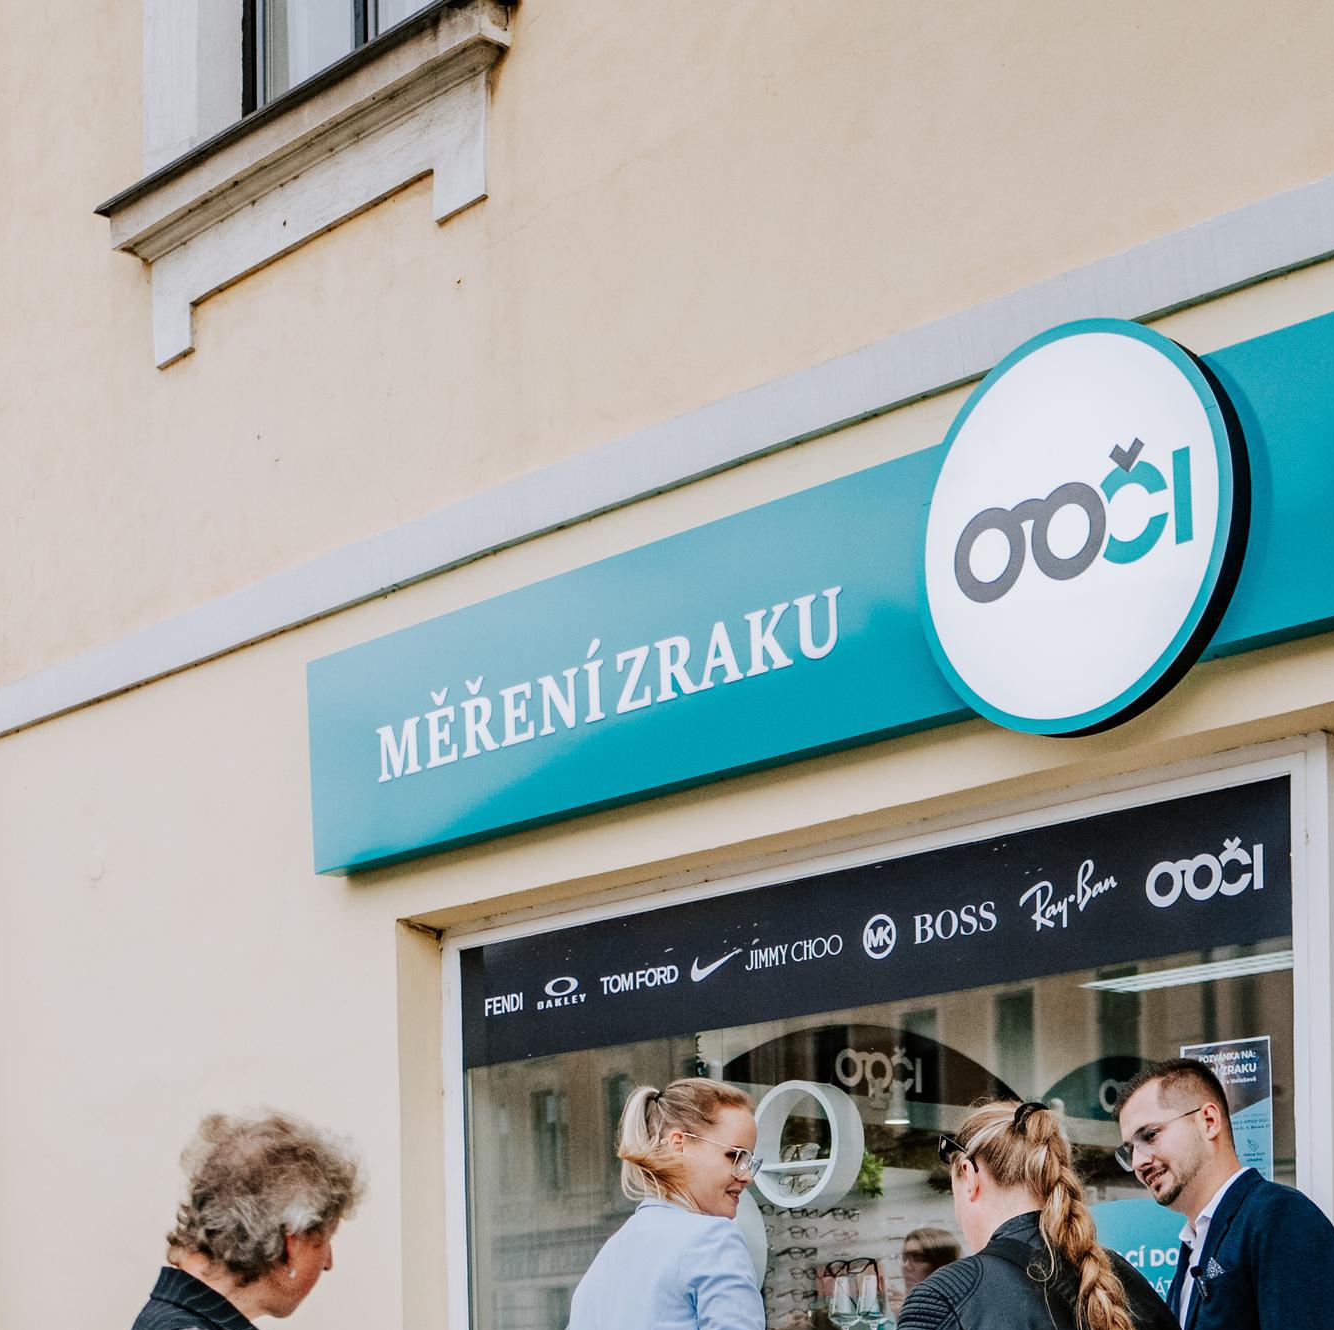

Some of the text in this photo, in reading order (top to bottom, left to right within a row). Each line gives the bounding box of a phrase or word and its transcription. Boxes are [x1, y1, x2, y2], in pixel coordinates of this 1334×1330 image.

[376, 586, 842, 783] MĚŘENÍ ZRAKU
[913, 901, 998, 944] BOSS
[745, 934, 843, 971] JIMMY CHOO
[600, 965, 679, 995] TOM FORD
[484, 991, 524, 1017] FENDI
[537, 993, 586, 1011] OAKLEY
